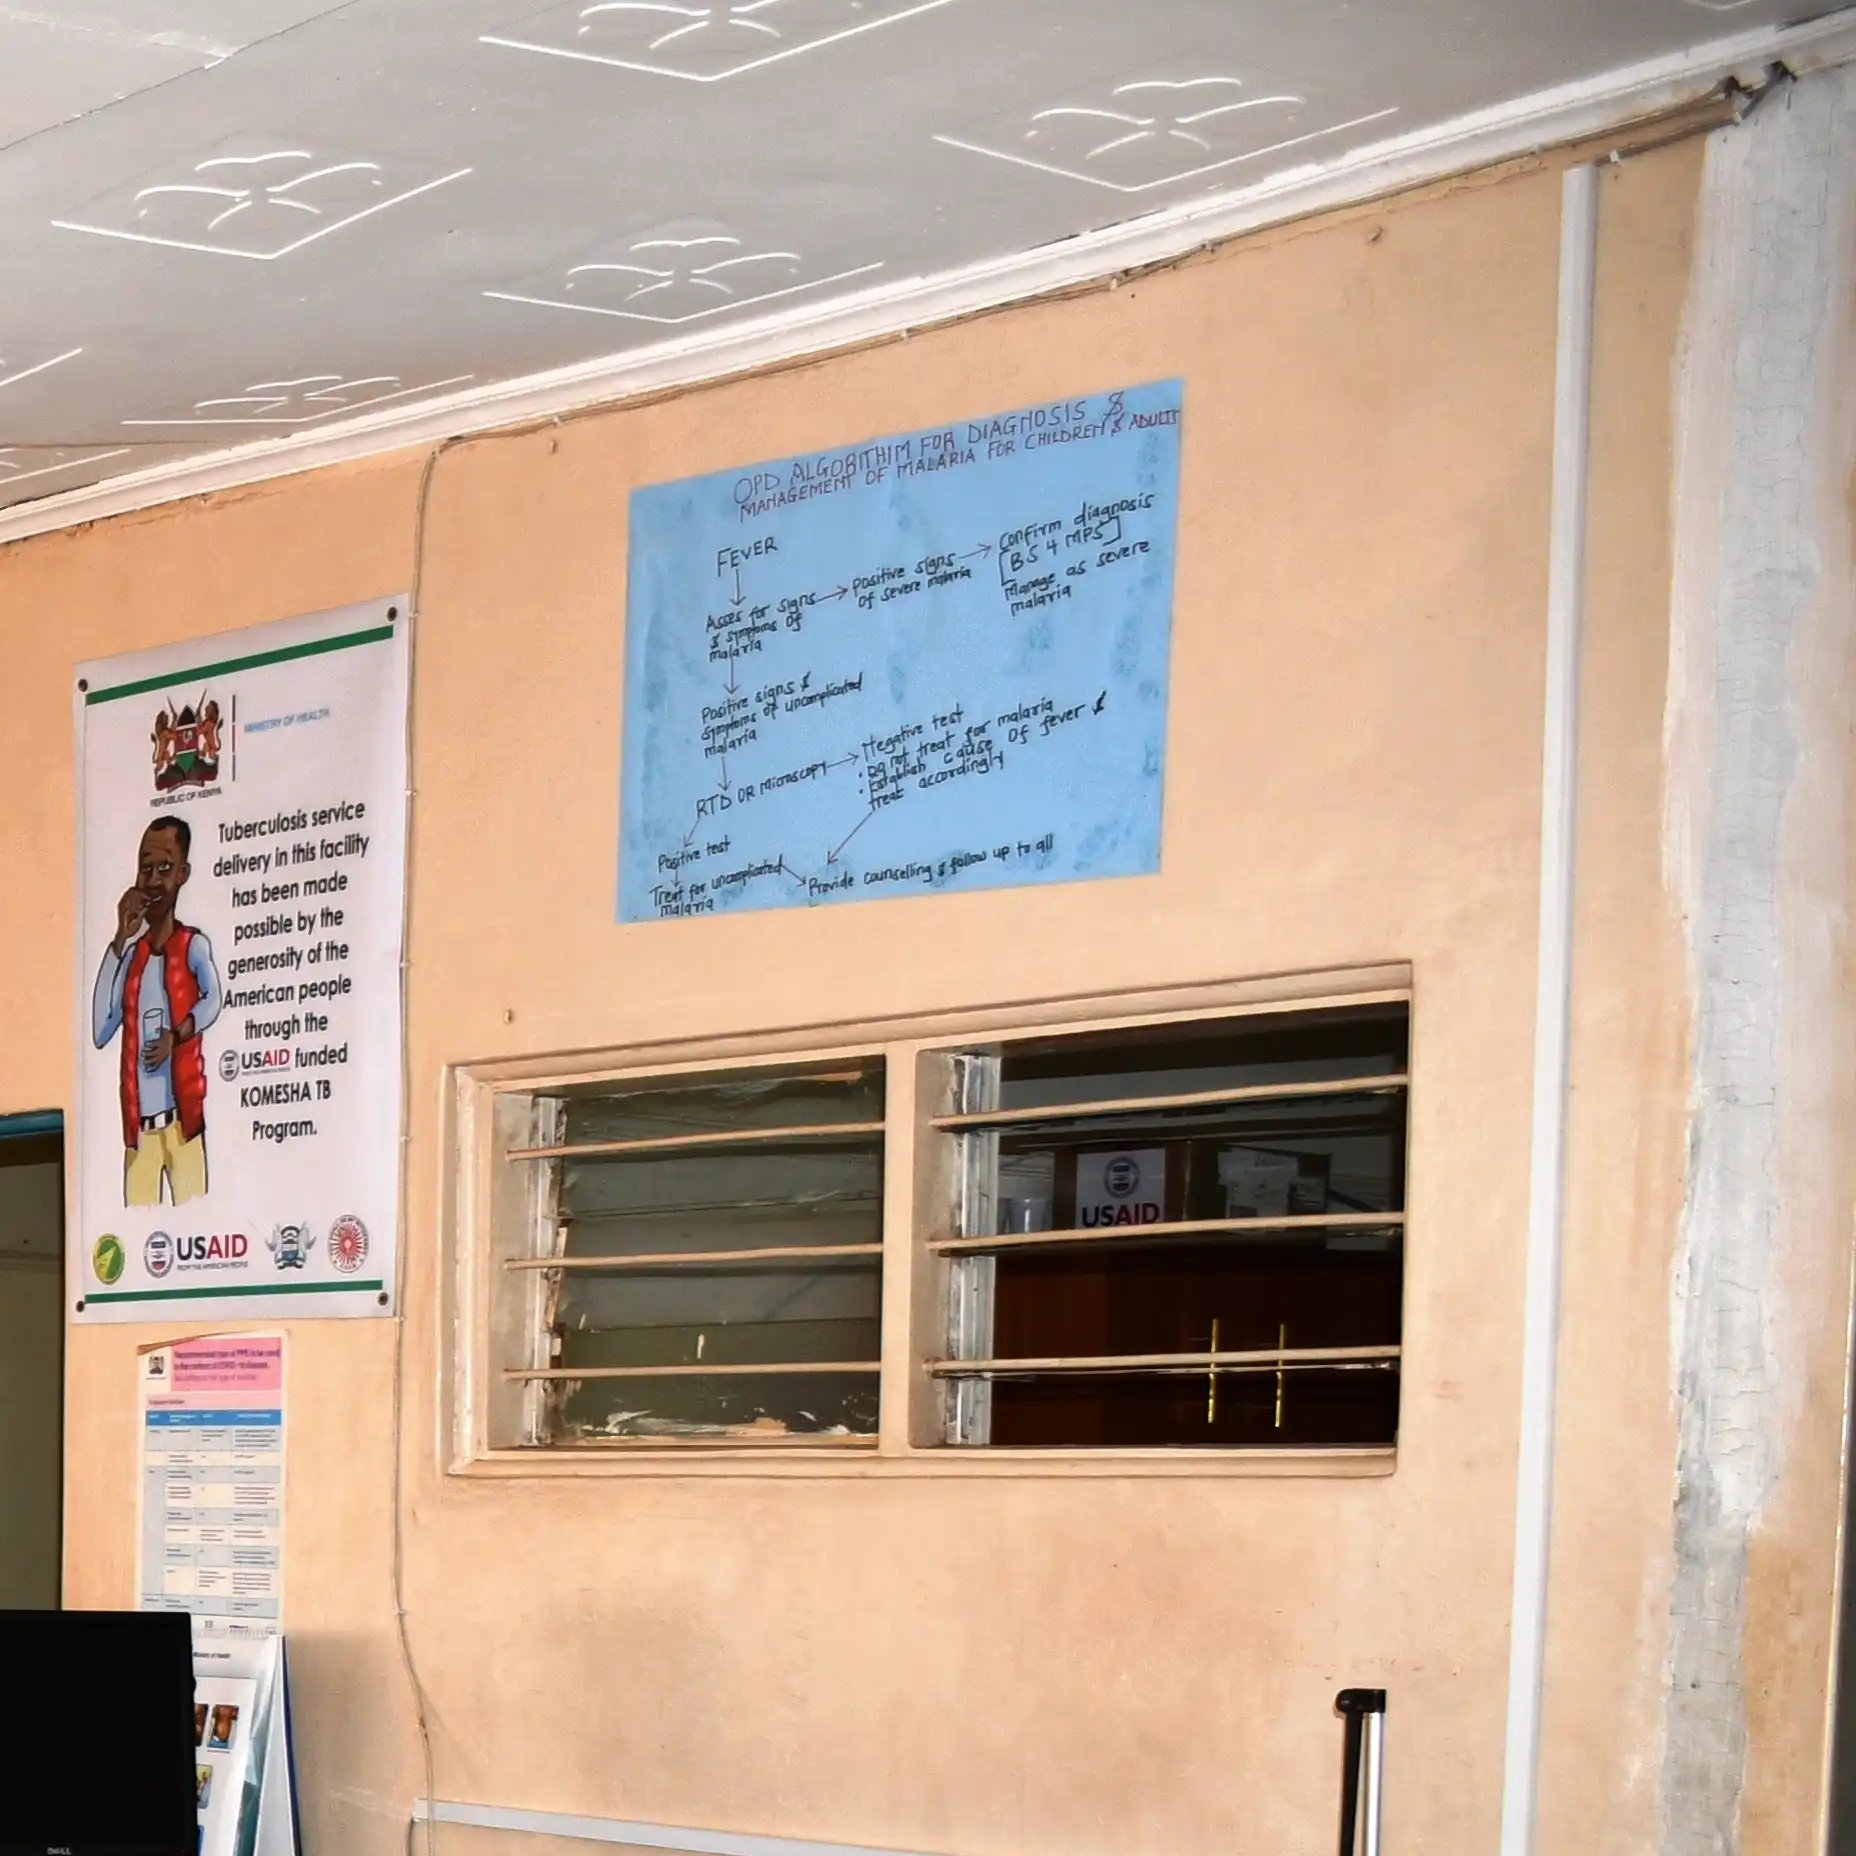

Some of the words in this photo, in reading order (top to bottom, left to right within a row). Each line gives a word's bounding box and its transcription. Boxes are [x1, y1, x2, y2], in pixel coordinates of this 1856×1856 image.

[734, 473, 780, 504] OPD
[921, 432, 955, 457] FOR
[968, 401, 1086, 444] DIAGNOSIS
[740, 474, 852, 523] MANAGEMENT
[865, 467, 888, 485] OF
[898, 449, 976, 479] MALARIA
[987, 440, 1015, 459] FOR
[1024, 422, 1106, 450] CHILDREN
[1073, 493, 1155, 527] diagnosis
[717, 536, 778, 577] FEVER
[1066, 560, 1086, 576] as
[1096, 541, 1150, 568] severe
[928, 567, 972, 588] malaria
[748, 605, 770, 627] for
[1010, 585, 1072, 617] malaria
[709, 640, 762, 662] malaria
[755, 681, 795, 703] signs
[244, 717, 282, 733] MINISTRY
[284, 716, 295, 726] OF
[297, 707, 329, 723] HEALTH
[917, 732, 956, 756] treat
[964, 720, 991, 739] for
[997, 697, 1054, 728] malaria
[932, 703, 964, 730] test
[704, 729, 757, 758] malaria
[943, 739, 993, 764] cause
[1039, 704, 1087, 737] fever
[868, 788, 904, 811] treat
[918, 750, 1004, 789] accordingly
[150, 792, 185, 807] REPUBLIC
[186, 791, 197, 801] OF
[696, 794, 732, 818] RTD
[738, 785, 755, 803] OR
[218, 809, 307, 843] Tuberculosis
[312, 801, 365, 827] service
[213, 853, 271, 877] delivery
[275, 847, 287, 867] in
[292, 841, 316, 864] this
[320, 833, 369, 859] facility
[706, 835, 731, 857] test
[808, 871, 854, 897] Provide
[863, 863, 932, 885] counselling
[949, 851, 987, 876] follow
[993, 846, 1010, 862] up
[1017, 841, 1030, 857] to
[1036, 832, 1053, 853] all
[232, 888, 257, 908] has
[261, 882, 299, 903] been
[303, 870, 348, 896] made
[649, 885, 685, 906] Treat
[689, 882, 706, 898] for
[660, 898, 714, 917] malaria
[234, 914, 293, 945] possible
[297, 911, 316, 935] by
[321, 906, 343, 928] the
[228, 947, 303, 980] generosity
[308, 942, 322, 964] of
[326, 941, 349, 962] the
[223, 984, 294, 1009] American
[299, 973, 351, 1004] people
[245, 1014, 300, 1040] through
[305, 1012, 328, 1032] the
[241, 1048, 290, 1069] USAID
[295, 1042, 347, 1068] funded
[241, 1081, 311, 1108] KOMESHA
[316, 1080, 331, 1100] TB
[252, 1120, 317, 1143] Program.
[1082, 1203, 1160, 1227] USAID
[177, 1234, 248, 1261] USAID
